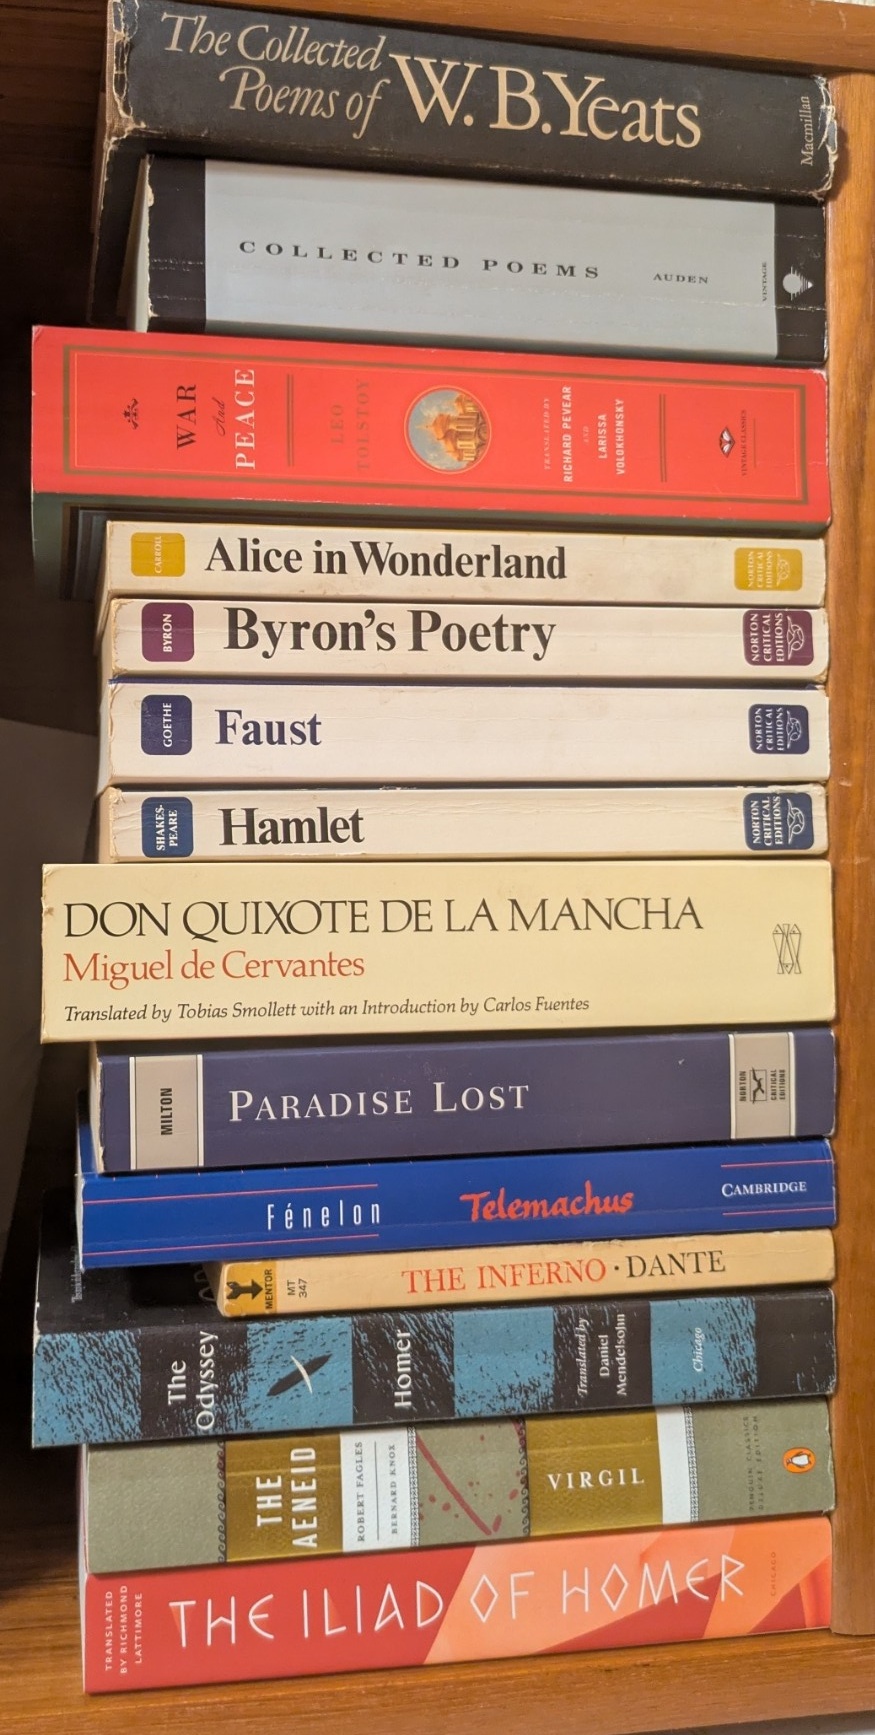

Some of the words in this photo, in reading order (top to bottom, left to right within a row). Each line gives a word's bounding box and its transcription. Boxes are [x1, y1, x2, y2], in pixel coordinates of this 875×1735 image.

[161, 12, 231, 56] The
[237, 25, 387, 71] Collected
[219, 65, 340, 118] Poems
[345, 78, 391, 139] of
[799, 96, 814, 167] Macmillan
[239, 241, 459, 269] COLLECTED
[482, 258, 599, 279] POEMS
[653, 273, 709, 284] AUDEN
[177, 384, 197, 450] WAR
[212, 397, 225, 437] And
[235, 369, 256, 469] PEACE
[330, 404, 344, 444] LEO
[356, 379, 370, 471] TOLSTOY
[561, 386, 571, 429] PEVEAR
[562, 434, 573, 482] RICHARD
[597, 414, 607, 459] LARISSA
[615, 399, 626, 475] VOLOKHONSKY
[154, 535, 162, 574] CARROLL
[204, 537, 303, 573] Alice
[313, 540, 348, 575] in
[349, 540, 568, 580] Wonderland
[162, 613, 173, 653] BYRON
[223, 607, 397, 659] Byron's
[406, 609, 557, 662] Poetry
[750, 613, 760, 662] NORTON
[762, 613, 773, 662] CRITICAL
[774, 612, 785, 662] EDITIONS
[162, 702, 173, 748] GOETHE
[214, 709, 322, 746] Faust
[755, 708, 763, 750] NORTON
[765, 708, 774, 751] CRITICAL
[776, 707, 784, 751] EDITIONS
[155, 804, 166, 851] SHAKES-
[168, 809, 178, 847] PEARE
[217, 806, 365, 846] Hamlet
[750, 800, 761, 844] NORTON
[762, 796, 773, 847] CRITICAL
[772, 795, 783, 845] EDITIONS
[64, 901, 172, 938] DON
[182, 900, 371, 943] QUIXOTE
[380, 899, 433, 933] DE
[444, 898, 499, 932] LA
[508, 896, 704, 931] MANCHA
[63, 949, 174, 990] Miguel
[181, 949, 215, 979] de
[222, 950, 365, 979] Cervantes
[65, 1004, 148, 1022] Translated
[152, 1003, 172, 1023] by
[178, 1002, 228, 1019] Tobias
[232, 1001, 297, 1018] Smollett
[300, 1000, 335, 1016] with
[339, 1003, 358, 1015] an
[362, 999, 456, 1015] Introduction
[460, 997, 479, 1016] by
[483, 997, 532, 1013] Carlos
[535, 996, 590, 1012] Fuentes
[229, 1090, 412, 1121] PARADISE
[433, 1081, 529, 1112] LOST
[739, 1071, 747, 1101] NORTON
[160, 1087, 173, 1136] MILTON
[460, 1180, 634, 1222] Telemachus
[721, 1181, 807, 1198] CAMBRIDGE
[267, 1200, 379, 1230] Fénelon
[264, 1269, 273, 1309] MENTOR
[287, 1279, 296, 1296] MT
[298, 1278, 308, 1298] 347
[401, 1267, 466, 1294] THE
[477, 1258, 607, 1289] INFERNO
[626, 1250, 726, 1278] DANTE
[576, 1317, 590, 1331] by
[394, 1329, 412, 1408] Homer
[575, 1333, 588, 1398] Translated
[598, 1335, 610, 1377] Daniel
[615, 1313, 627, 1396] Mendelsohn
[692, 1327, 706, 1373] Chicago
[167, 1360, 187, 1405] The
[195, 1330, 219, 1430] Odyssey
[389, 1444, 397, 1476] KNOX
[743, 1416, 752, 1462] CLASSICS
[753, 1415, 763, 1462] EDITION
[355, 1441, 364, 1488] FAGLES
[547, 1467, 645, 1491] VIRGIL
[256, 1475, 283, 1528] THE
[290, 1447, 318, 1549] AENEID
[390, 1481, 398, 1535] BERNARD
[757, 1471, 765, 1511] DELUXE
[357, 1492, 366, 1542] ROBERT
[769, 1551, 777, 1597] CHICAGO
[120, 1585, 128, 1654] RICHMOND
[168, 1594, 275, 1648] THE
[302, 1580, 444, 1639] ILIAD
[470, 1571, 535, 1623] OF
[562, 1554, 745, 1615] HOMER
[105, 1591, 113, 1671] TRANSLATED
[134, 1592, 143, 1664] LATTIMORE
[120, 1658, 128, 1674] BY
